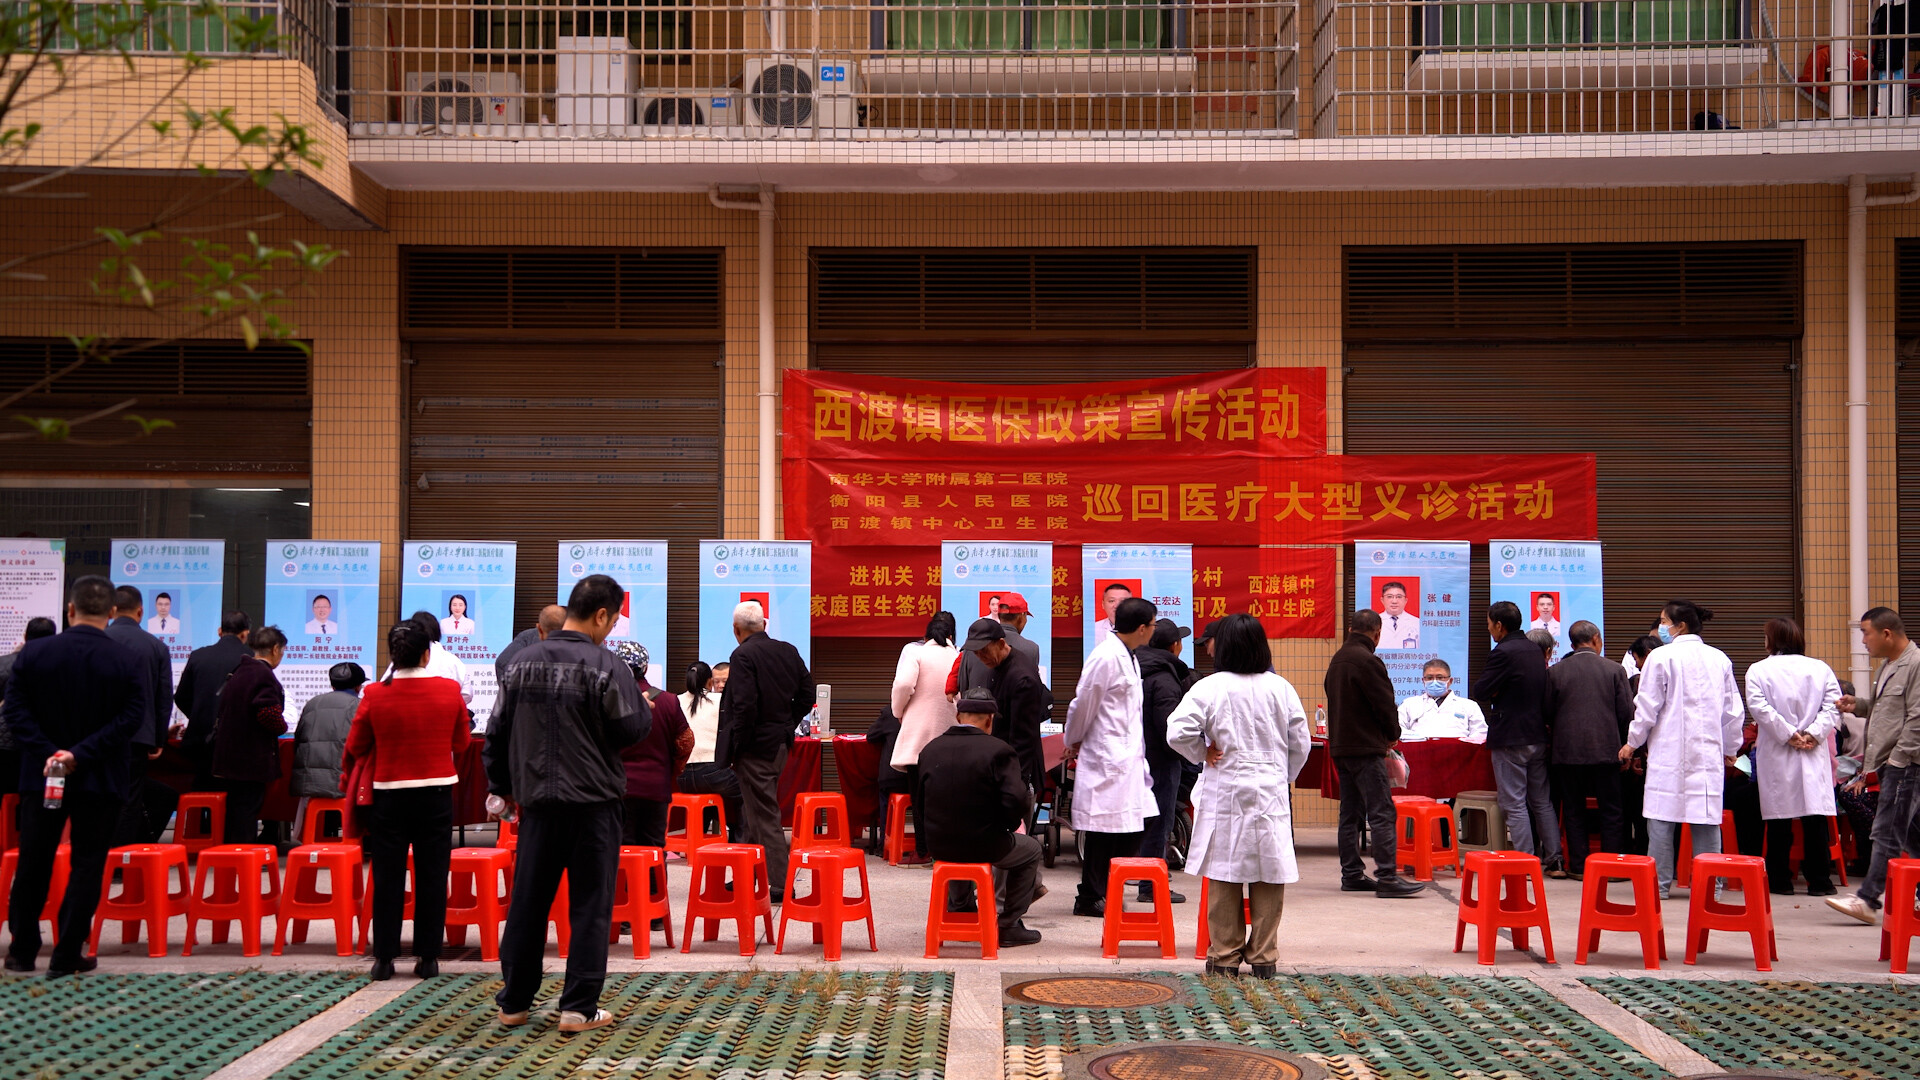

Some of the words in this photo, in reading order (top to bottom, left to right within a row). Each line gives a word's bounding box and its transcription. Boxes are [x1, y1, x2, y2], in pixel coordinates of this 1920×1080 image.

[823, 69, 844, 78] Miea
[813, 385, 1300, 443] 西渡镇医保政策宣传活动
[828, 471, 1069, 486] 南华大学附属第二医院
[829, 493, 1069, 508] 衡阳县人民医院
[1082, 480, 1555, 523] 巡回医疗大型义诊活动
[830, 516, 1069, 530] 西渡镇中心卫生院
[850, 565, 914, 587] 进机关
[1248, 574, 1315, 594] 西渡镇中
[811, 594, 937, 617] 家庭医生签约
[1152, 596, 1181, 606] 王宏达
[1248, 598, 1316, 618] 心卫生院
